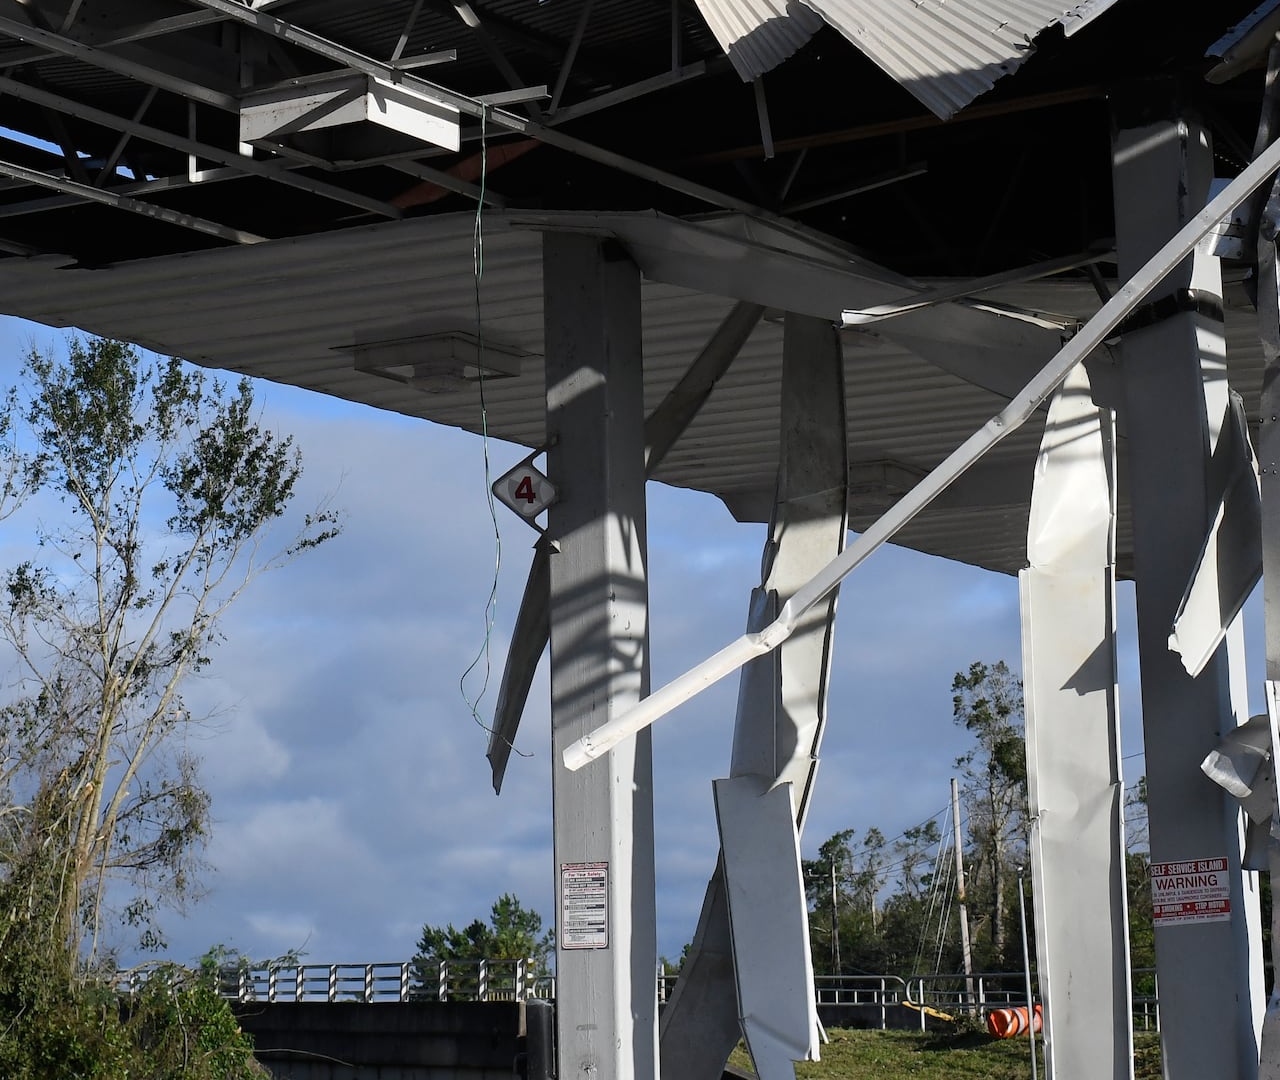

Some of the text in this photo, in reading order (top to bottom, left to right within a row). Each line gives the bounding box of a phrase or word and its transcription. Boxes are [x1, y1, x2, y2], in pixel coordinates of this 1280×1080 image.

[514, 476, 536, 504] 4
[1151, 859, 1223, 877] SELF SERVICE ISLAND
[1155, 874, 1218, 891] WARNING
